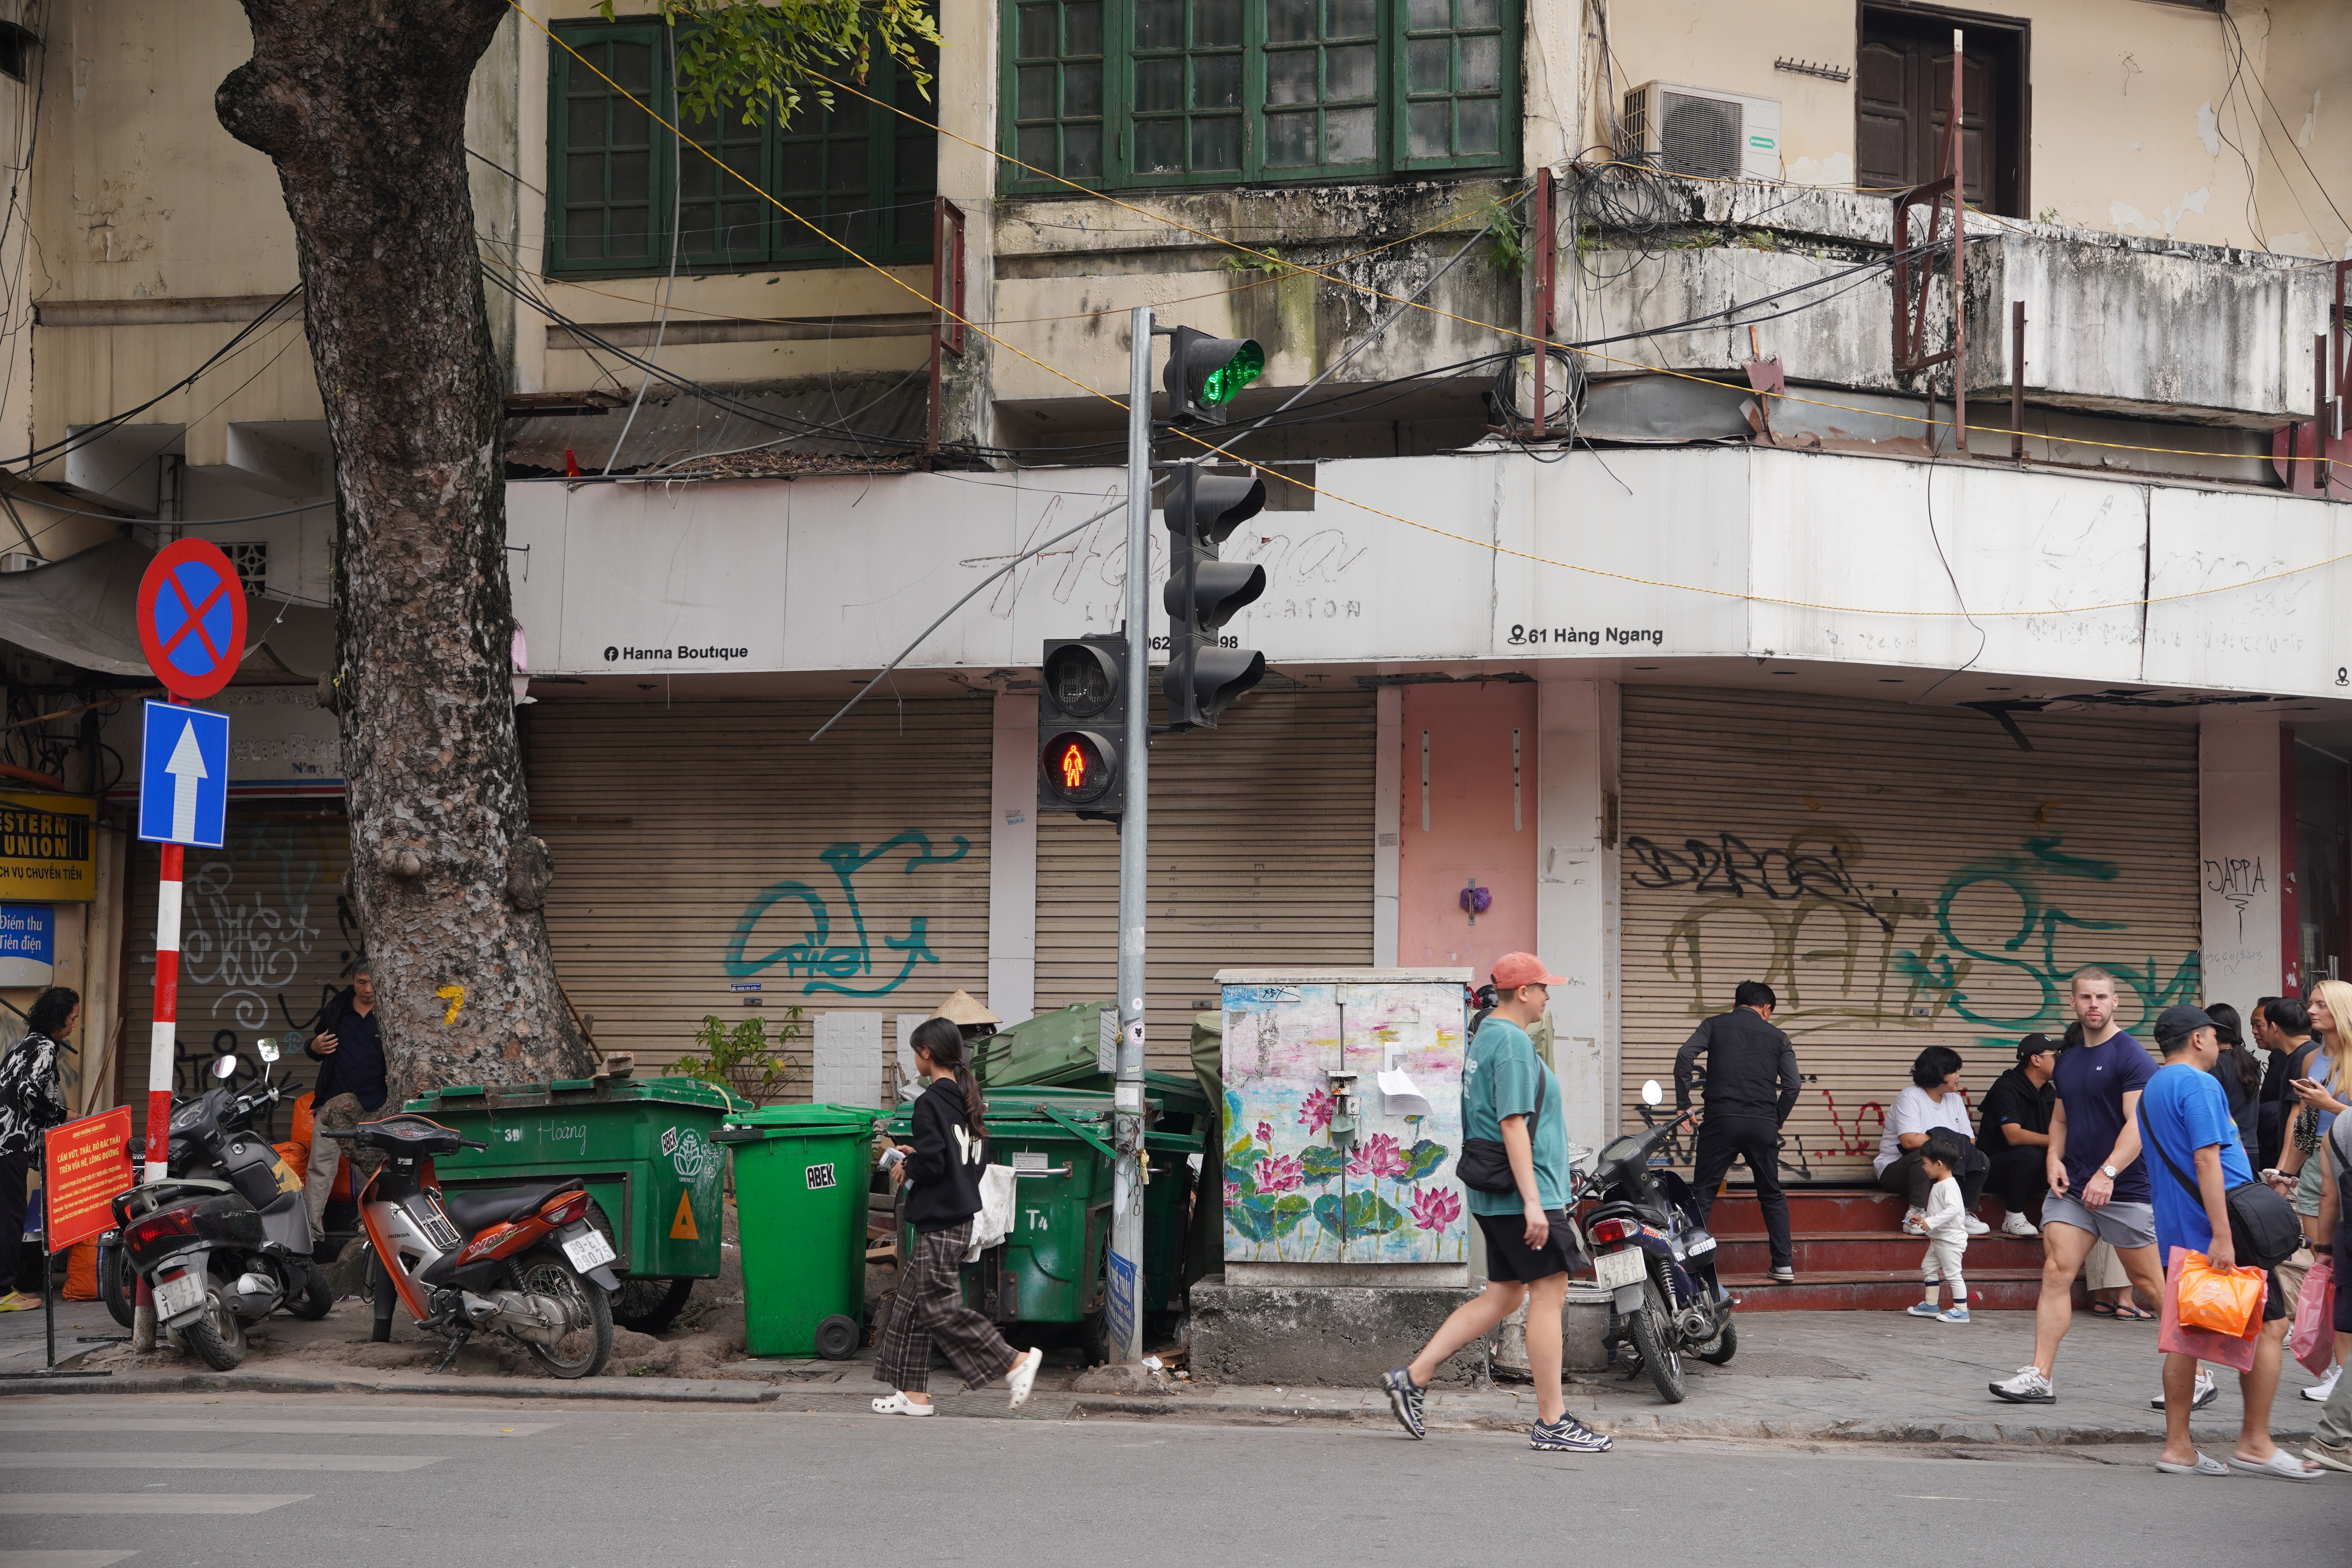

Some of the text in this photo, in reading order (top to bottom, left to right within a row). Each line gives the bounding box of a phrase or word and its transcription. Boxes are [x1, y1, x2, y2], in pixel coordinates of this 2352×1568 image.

[1529, 627, 1663, 645] 61 Hàng Ngang
[623, 645, 748, 661] Hanna Boutique
[4, 835, 67, 857] UNION
[12, 867, 24, 880] VỤ
[26, 863, 61, 879] CHUYỂN
[63, 865, 82, 880] TIỀN
[27, 915, 42, 931] thu
[0, 934, 41, 954] Tiền điện
[58, 1134, 120, 1163] CẤM VỨT, THẢI, BỎ RÁC THẢI
[662, 1128, 677, 1154] ABEK
[59, 1163, 71, 1174] TRÊN
[89, 1154, 101, 1164] LÒNG
[102, 1148, 118, 1160] ĐƯỜNG
[808, 1165, 835, 1188] ABEK
[570, 1234, 600, 1255] 89-E1
[159, 1250, 180, 1260] HONDA
[575, 1246, 612, 1270] 090.75
[1602, 1252, 1637, 1270] 29-P2
[1604, 1267, 1639, 1287] 5260
[1534, 1425, 1553, 1438] SALOMON
